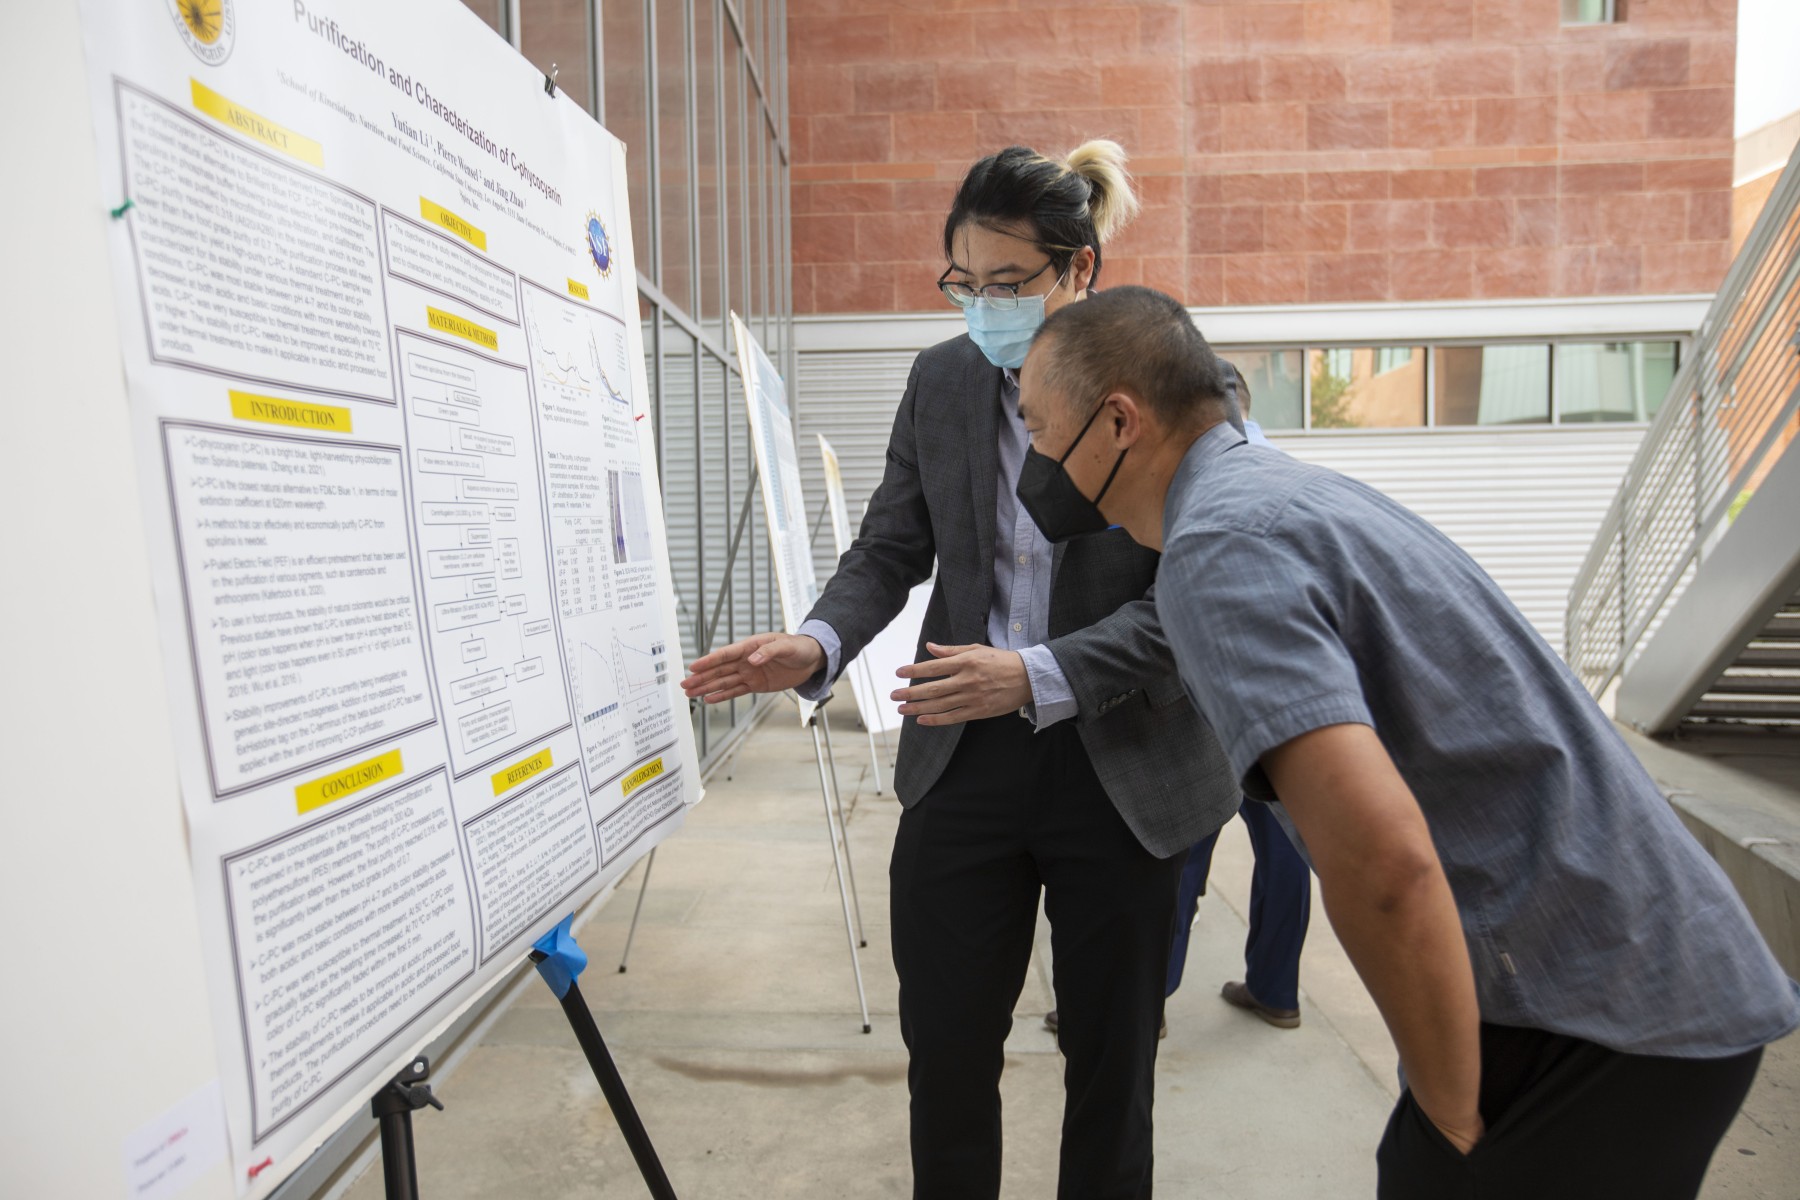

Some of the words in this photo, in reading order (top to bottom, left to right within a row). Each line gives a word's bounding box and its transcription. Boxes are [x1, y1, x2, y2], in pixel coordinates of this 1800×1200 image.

[293, 0, 385, 78] Purification
[389, 69, 412, 97] and
[415, 81, 499, 162] Characterization
[500, 147, 510, 165] of
[227, 109, 288, 148] ABSTRACT
[391, 111, 419, 143] Yutian
[440, 212, 472, 240] OBJECTIVE
[428, 311, 466, 333] MATERIALS
[473, 328, 498, 346] METHODS
[251, 400, 335, 425] INTRODUCTION
[321, 762, 384, 797] CONCLUSION
[507, 757, 543, 785] REFERENCES
